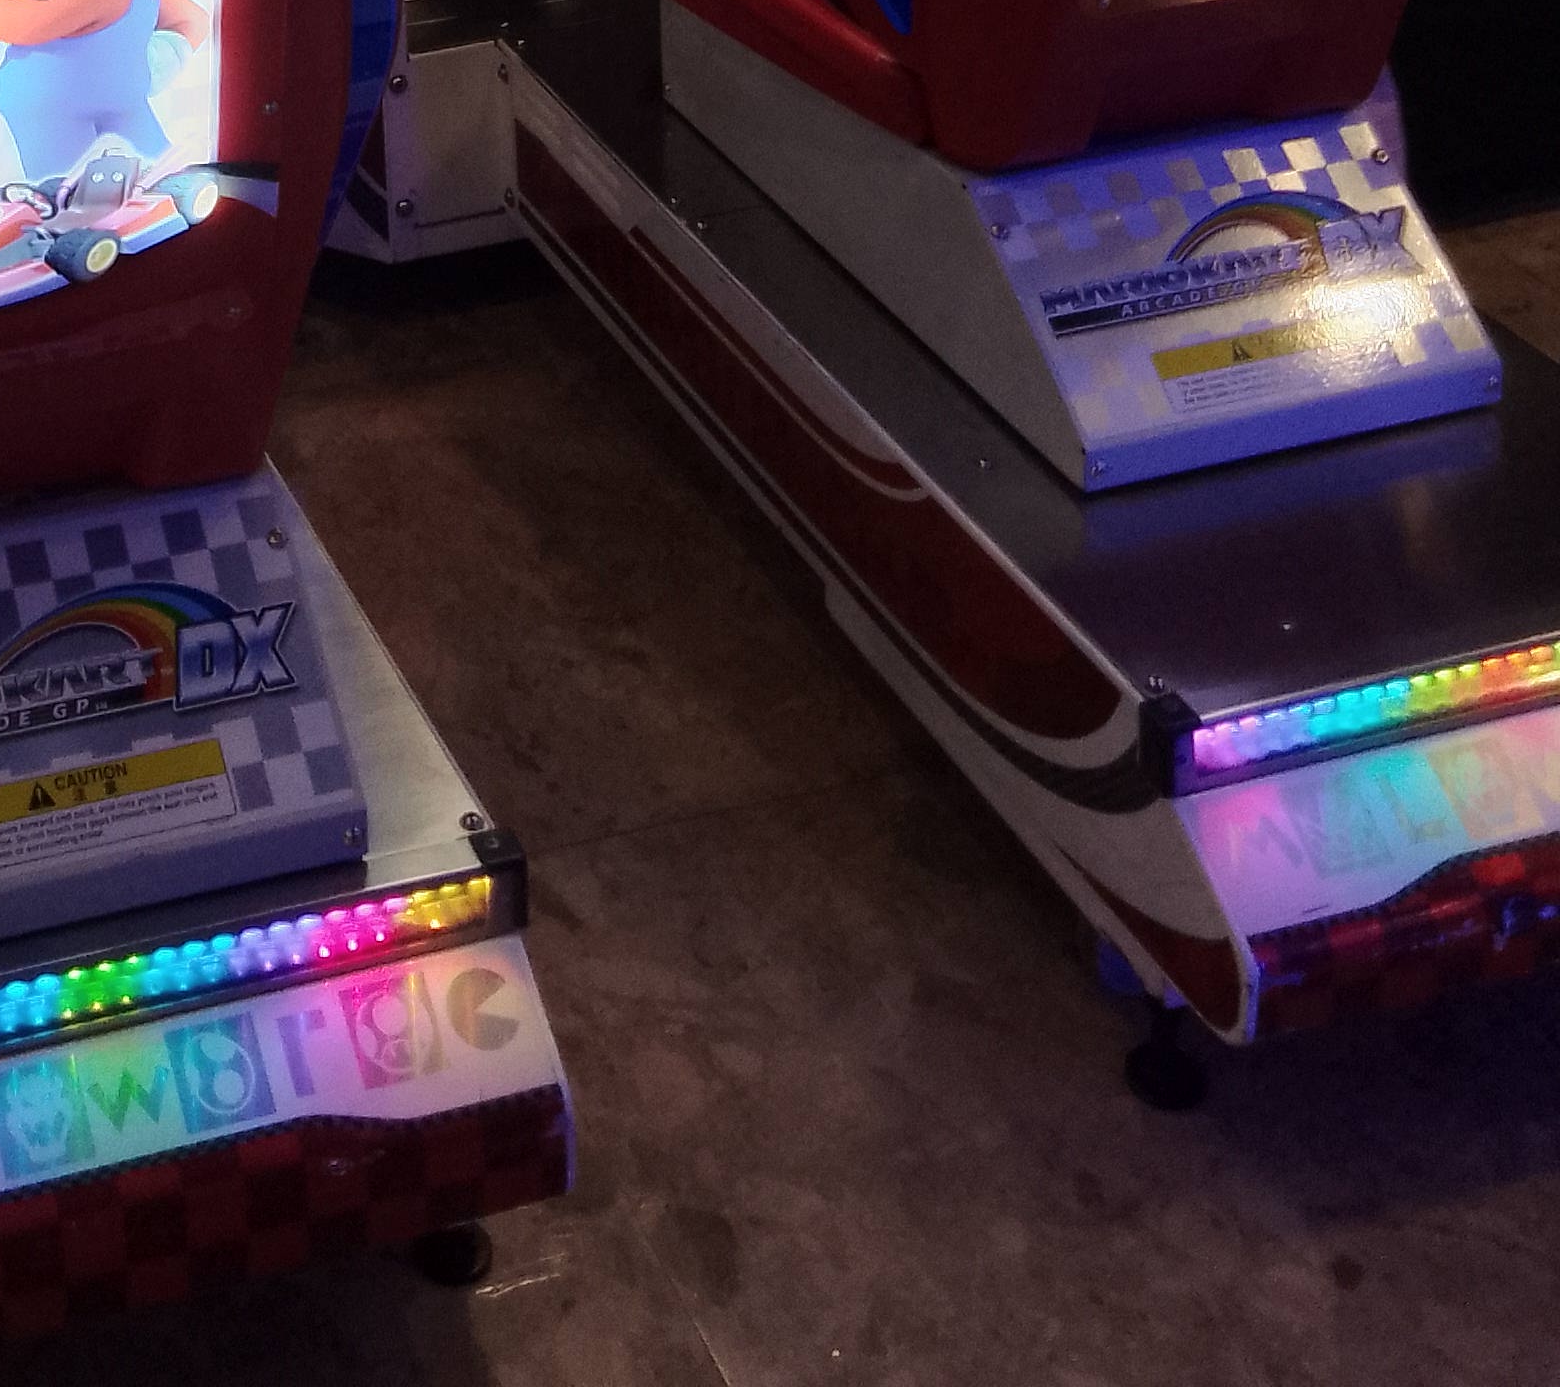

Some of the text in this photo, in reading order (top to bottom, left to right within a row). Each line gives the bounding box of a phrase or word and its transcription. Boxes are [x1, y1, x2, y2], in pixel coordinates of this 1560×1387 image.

[175, 602, 296, 711] DX
[52, 696, 93, 721] GP
[53, 762, 129, 792] CAUTION
